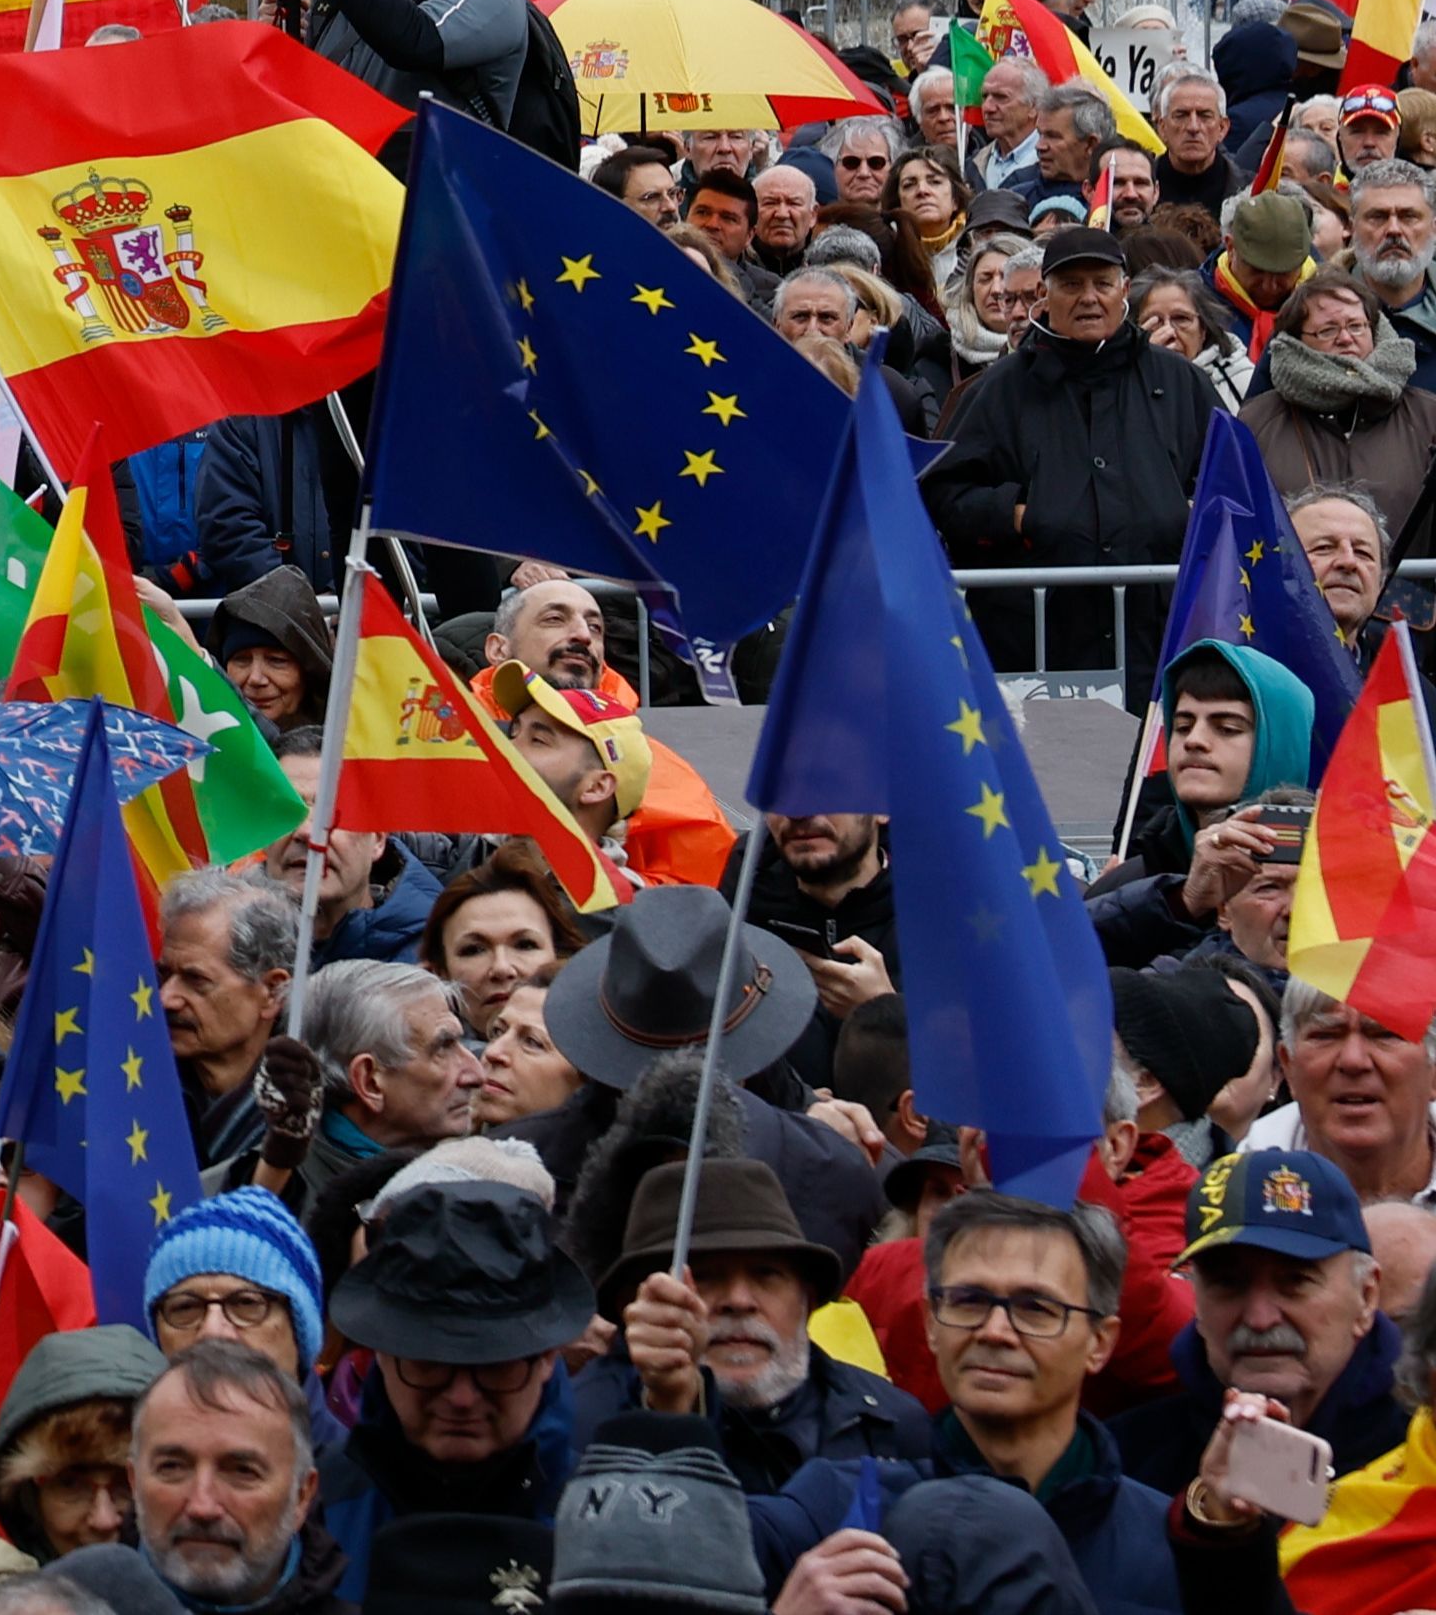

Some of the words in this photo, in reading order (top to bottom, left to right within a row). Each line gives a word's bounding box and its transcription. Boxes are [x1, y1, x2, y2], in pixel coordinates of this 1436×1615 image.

[1129, 44, 1155, 95] Ya
[169, 252, 201, 263] VLTRA
[58, 263, 83, 276] PLVS
